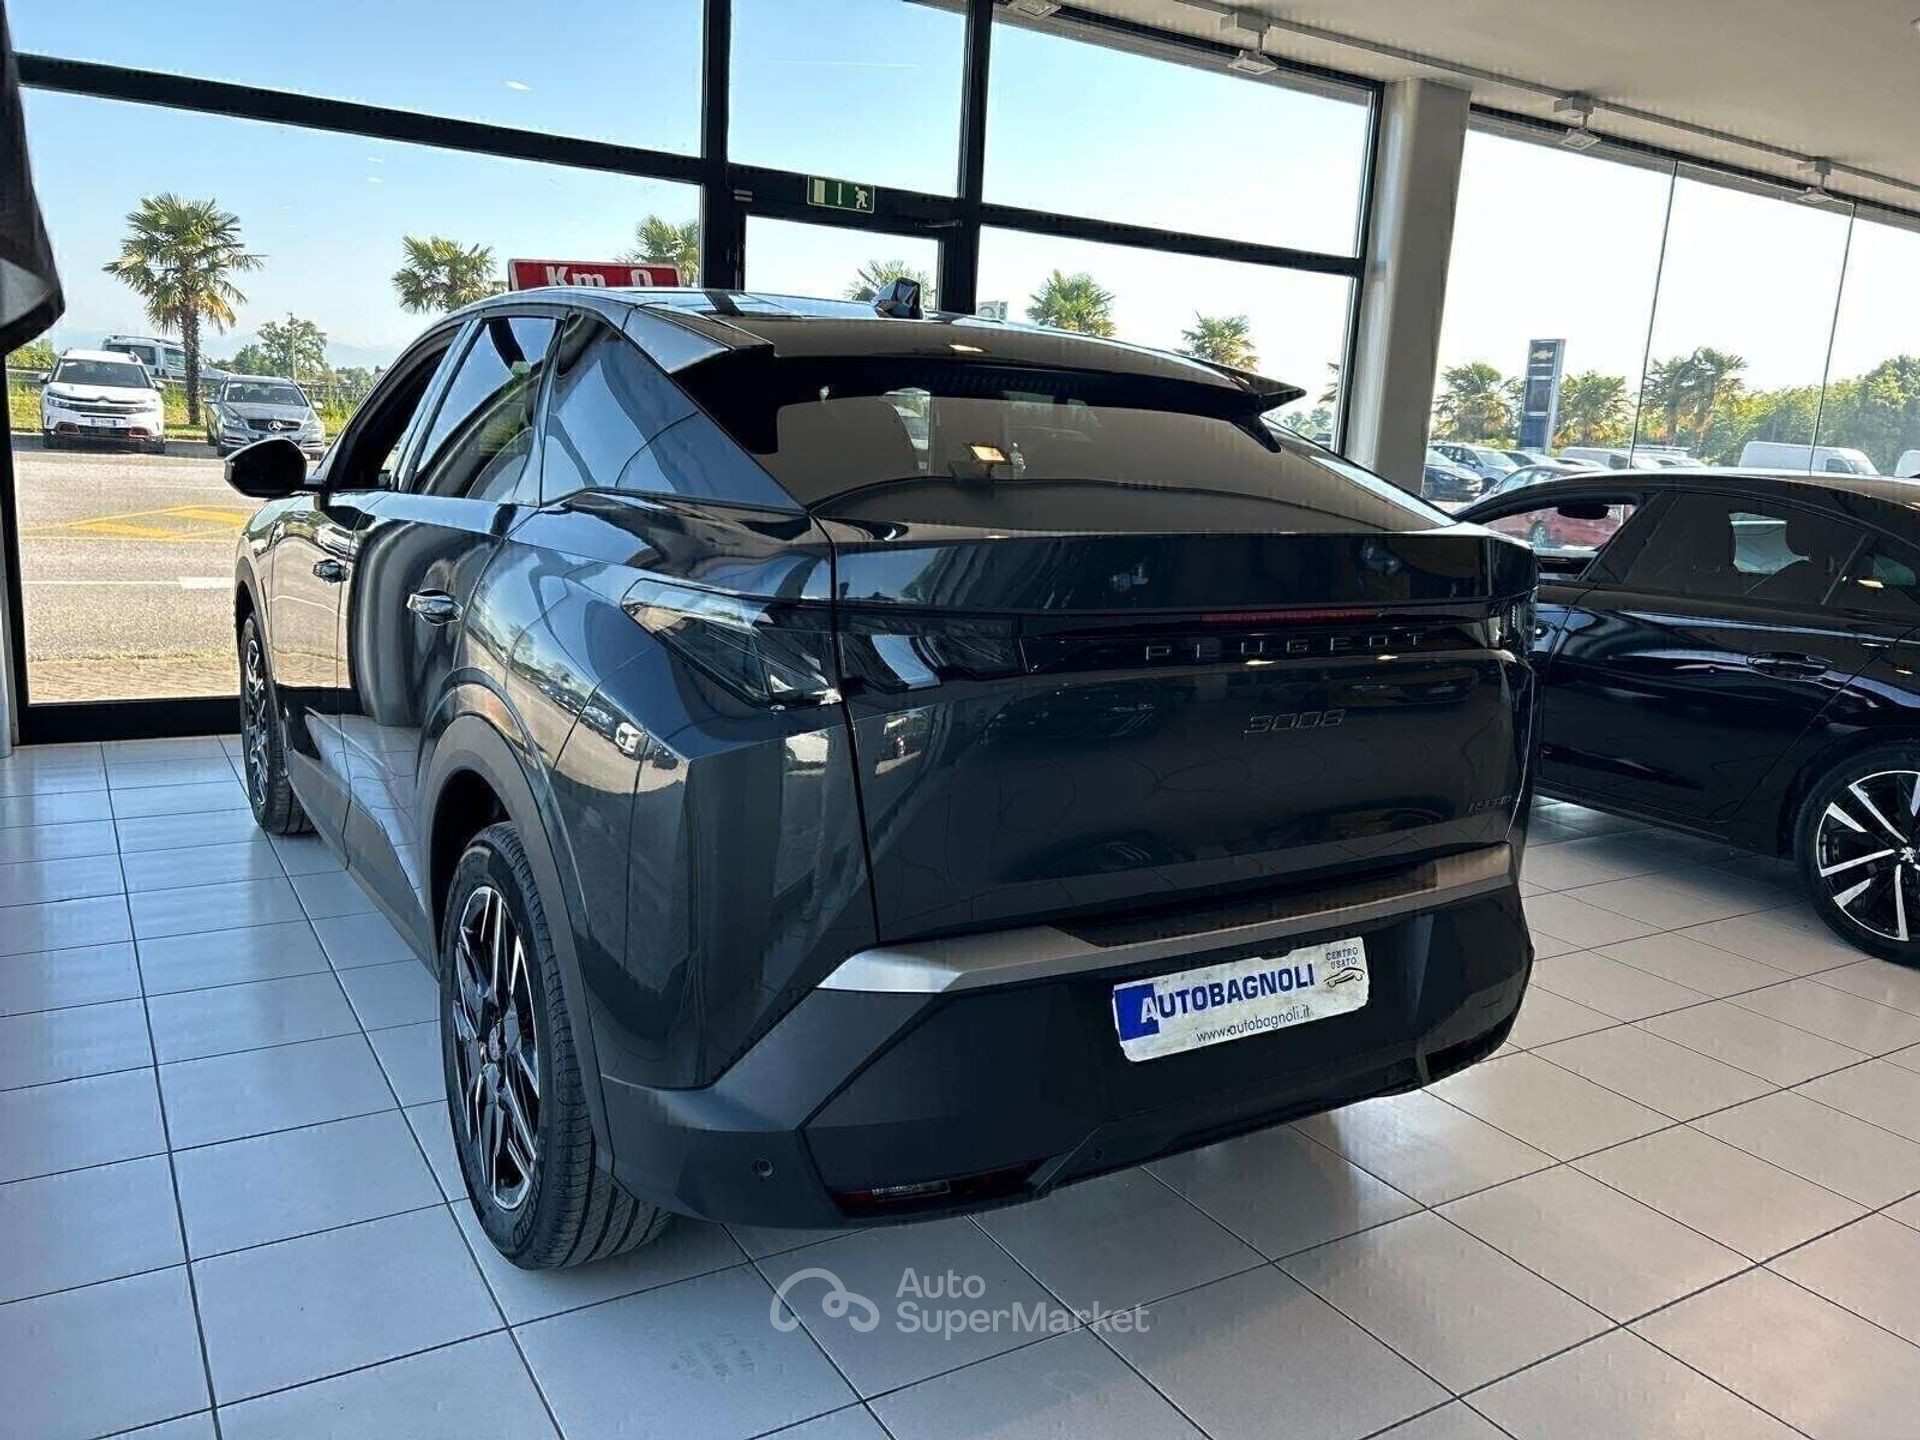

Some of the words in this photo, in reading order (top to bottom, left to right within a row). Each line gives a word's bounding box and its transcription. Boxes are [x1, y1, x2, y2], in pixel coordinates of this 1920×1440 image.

[546, 266, 606, 287] Km
[1243, 709, 1346, 736] 3008
[1325, 946, 1359, 961] CENTRO
[1330, 956, 1358, 970] USATO
[1140, 963, 1315, 1024] AUTOBAGNOLI
[1196, 1004, 1311, 1043] www.autobagnoli.it
